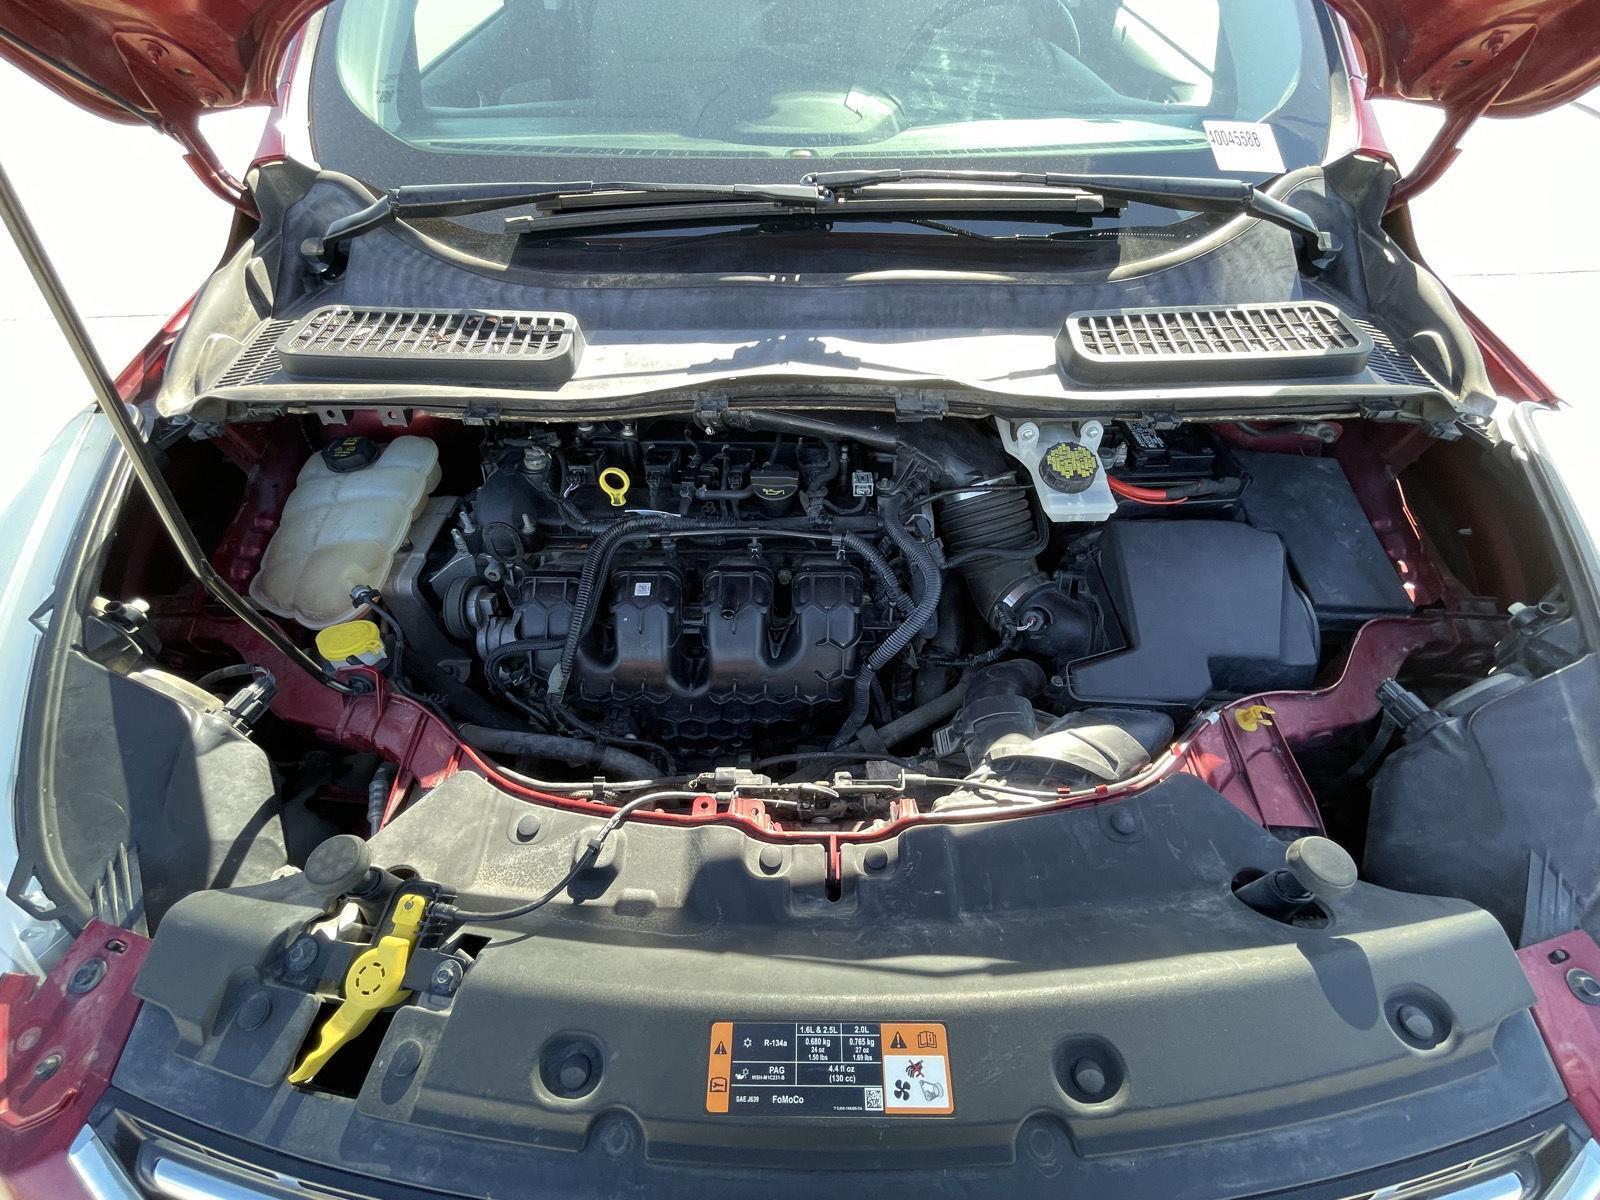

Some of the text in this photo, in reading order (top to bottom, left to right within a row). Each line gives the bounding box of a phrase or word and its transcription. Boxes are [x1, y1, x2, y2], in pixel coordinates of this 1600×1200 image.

[823, 1026, 838, 1034] 2.5L
[764, 1039, 788, 1047] R-134a
[805, 1037, 831, 1047] 0.680 kg
[849, 1037, 875, 1047] 0.765 kg
[820, 1053, 829, 1061] lbs
[769, 1066, 785, 1075] PAG
[829, 1074, 856, 1084] (130 cc)
[735, 1095, 747, 1103] SAE
[772, 1094, 804, 1104] FoMoCo
